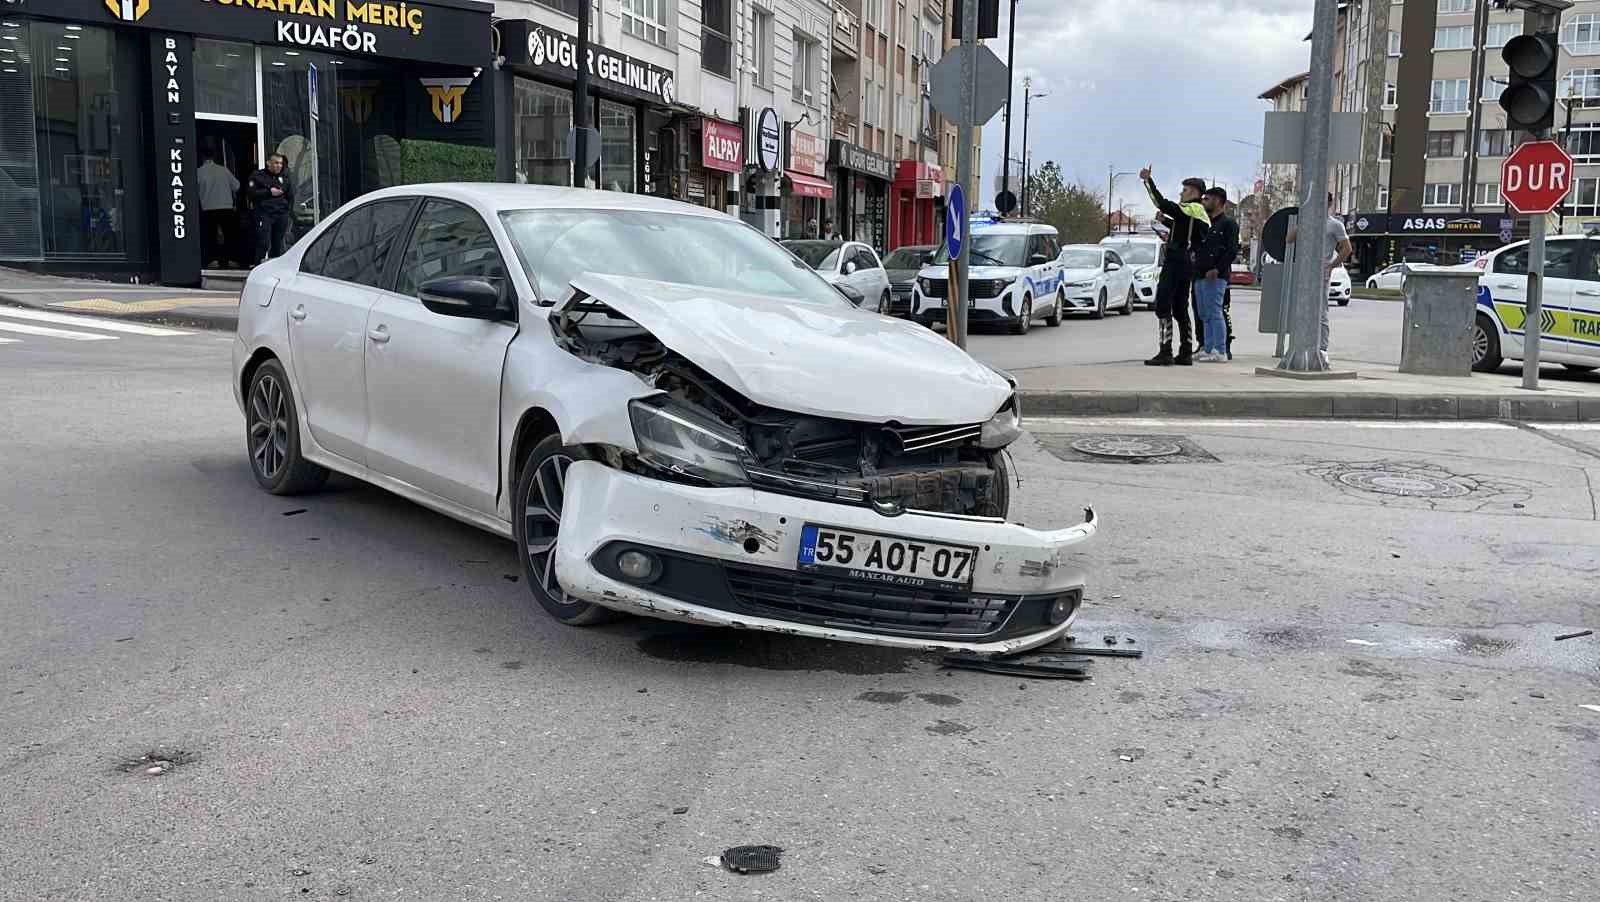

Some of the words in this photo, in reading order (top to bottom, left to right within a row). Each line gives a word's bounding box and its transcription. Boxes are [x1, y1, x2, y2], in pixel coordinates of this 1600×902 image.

[347, 1, 423, 35] MERİÇ
[277, 20, 377, 54] KUAFÖR
[165, 38, 180, 103] BAYAN
[597, 53, 662, 96] GELİNLİK
[708, 135, 741, 163] ALPAY
[170, 148, 186, 239] KUAFÖRÜ
[1505, 162, 1566, 192] DUR
[1403, 218, 1446, 230] ASAS
[803, 546, 815, 556] TR
[815, 531, 856, 564] 55
[864, 540, 926, 574] AOT
[932, 549, 971, 579] 07
[848, 568, 896, 583] MAXCAR
[895, 575, 925, 587] AUTO
